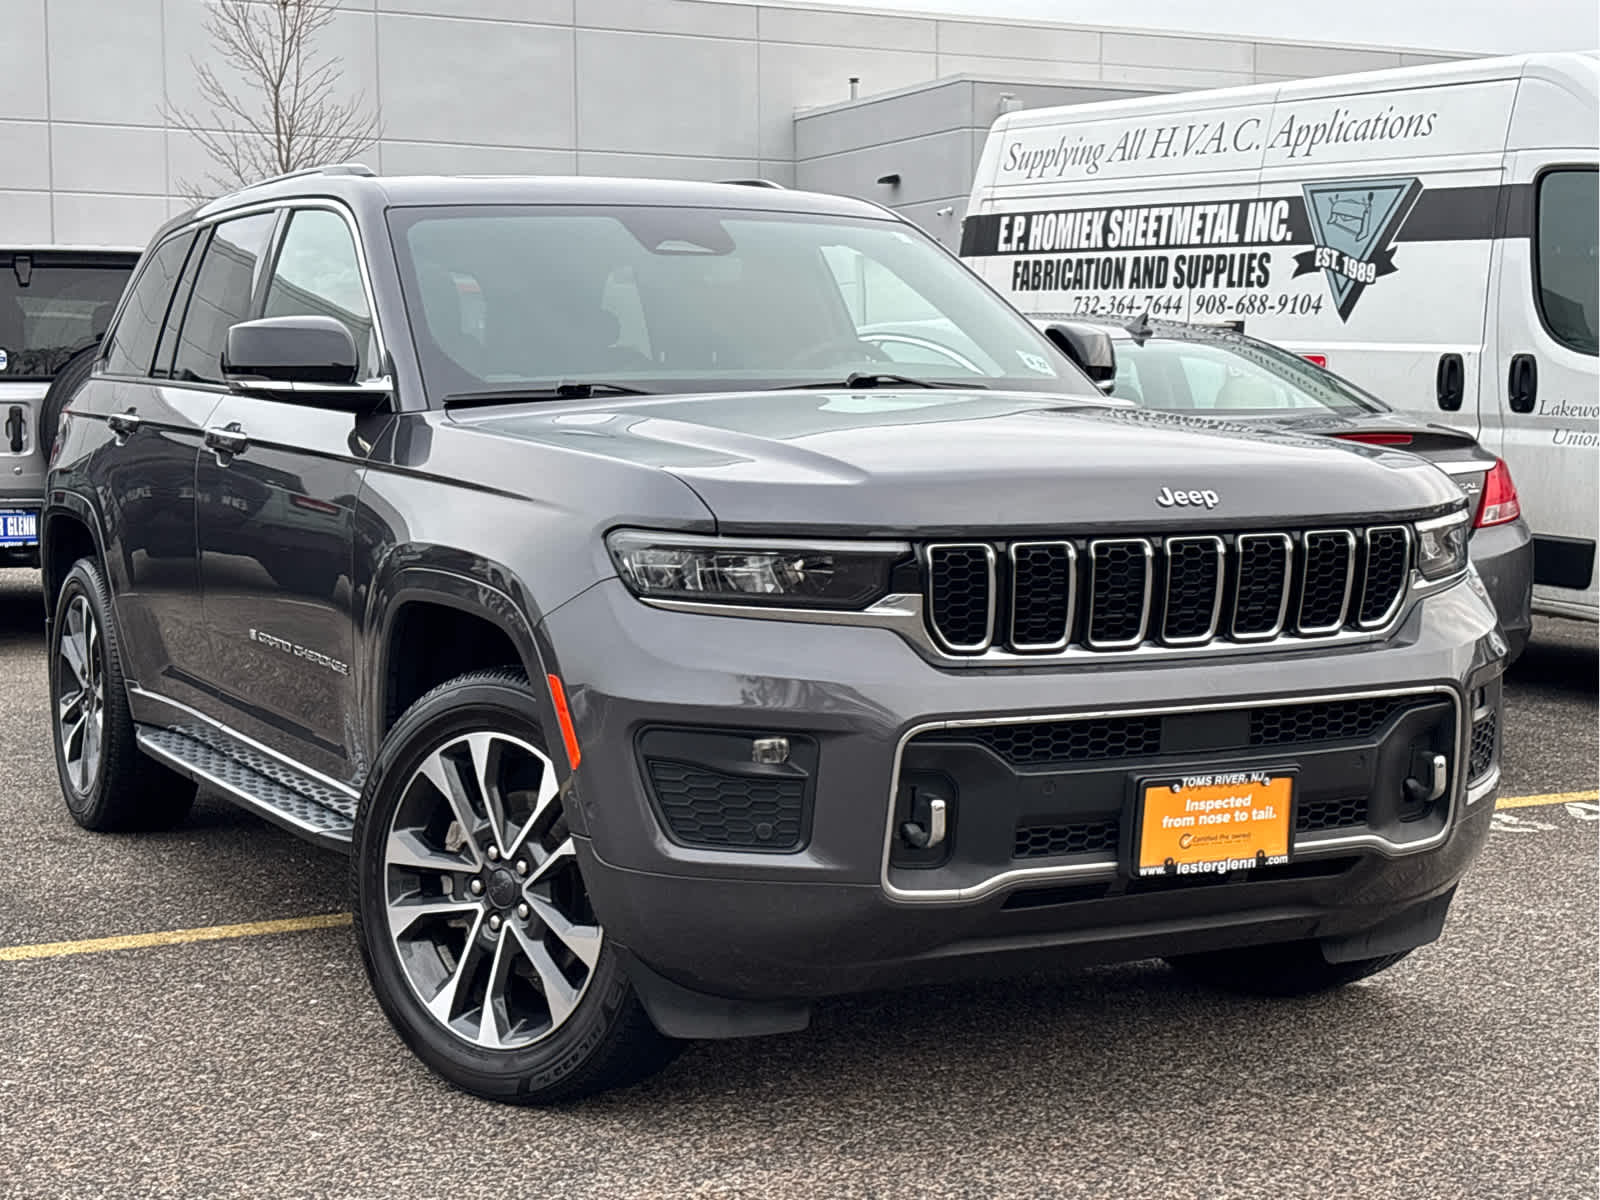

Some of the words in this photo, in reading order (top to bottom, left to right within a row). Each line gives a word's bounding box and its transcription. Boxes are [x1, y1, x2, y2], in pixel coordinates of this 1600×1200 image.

[1003, 136, 1105, 179] Supplying
[1105, 128, 1147, 163] All
[1147, 118, 1260, 159] H.V.A.C.
[1267, 105, 1437, 158] Applications
[997, 215, 1026, 252] E.P.
[1028, 210, 1107, 251] HOMIEK
[1107, 202, 1241, 248] SHEETMETAL
[1243, 199, 1293, 243] INC.
[1012, 257, 1127, 291] FABRICATION
[1128, 256, 1169, 290] AND
[1173, 252, 1271, 289] SUPPLIES
[1314, 247, 1340, 271] EST.
[1341, 256, 1376, 283] 1989
[1073, 295, 1183, 315] 732-364-7644
[1194, 293, 1323, 315] 908-688-9104
[1156, 486, 1220, 510] Jeep
[7, 517, 37, 536] GLENN
[1181, 776, 1212, 788] TOMS
[1214, 773, 1248, 786] RIVER,
[1185, 794, 1253, 812] Inspected
[1162, 815, 1195, 829] from
[1198, 812, 1231, 825] nose
[1234, 809, 1248, 822] to
[1251, 805, 1277, 820] tail.
[1139, 865, 1166, 877] www.
[1176, 857, 1257, 876] lesterglenn
[1264, 854, 1289, 866] .com
